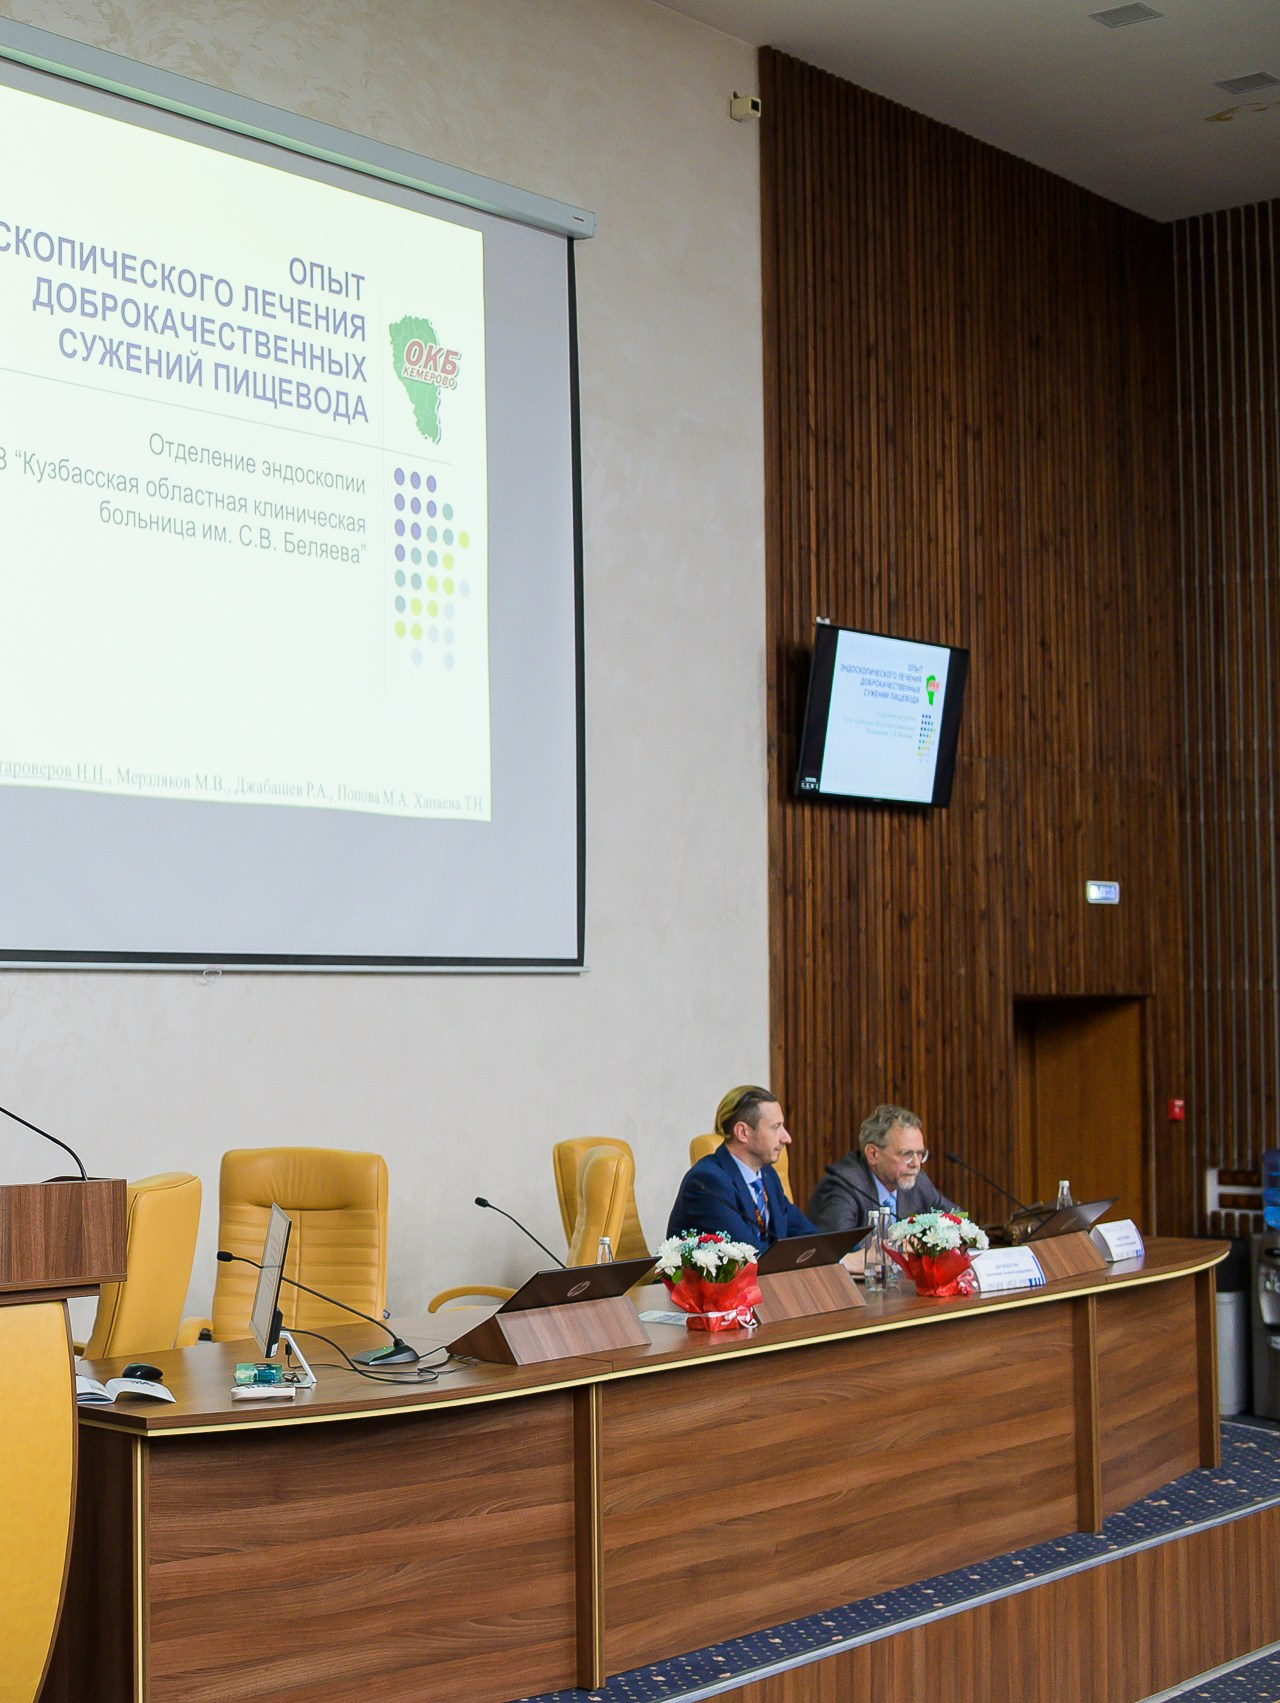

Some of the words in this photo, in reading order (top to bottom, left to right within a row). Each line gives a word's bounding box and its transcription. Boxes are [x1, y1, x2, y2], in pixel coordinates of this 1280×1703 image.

[288, 257, 365, 301] ОПЫТ
[33, 276, 368, 383] ДОБРОКАЧЕСТВЕННЫХ
[242, 288, 366, 342] ЛЕЧЕНИЯ
[59, 328, 204, 389] СУЖЕНИЙ
[214, 363, 369, 423] ПИЩЕВОДА
[402, 366, 455, 388] КЕМЕРОВО
[405, 340, 459, 375] ОКБ
[149, 432, 256, 474] Отделение
[262, 459, 365, 495] эндоскопии
[100, 501, 196, 539] больница
[202, 524, 234, 544] им.
[239, 526, 278, 552] С.В.
[146, 478, 248, 514] областная
[253, 501, 366, 534] клиническая
[117, 767, 191, 789] Мерзляков
[337, 784, 380, 805] Попова
